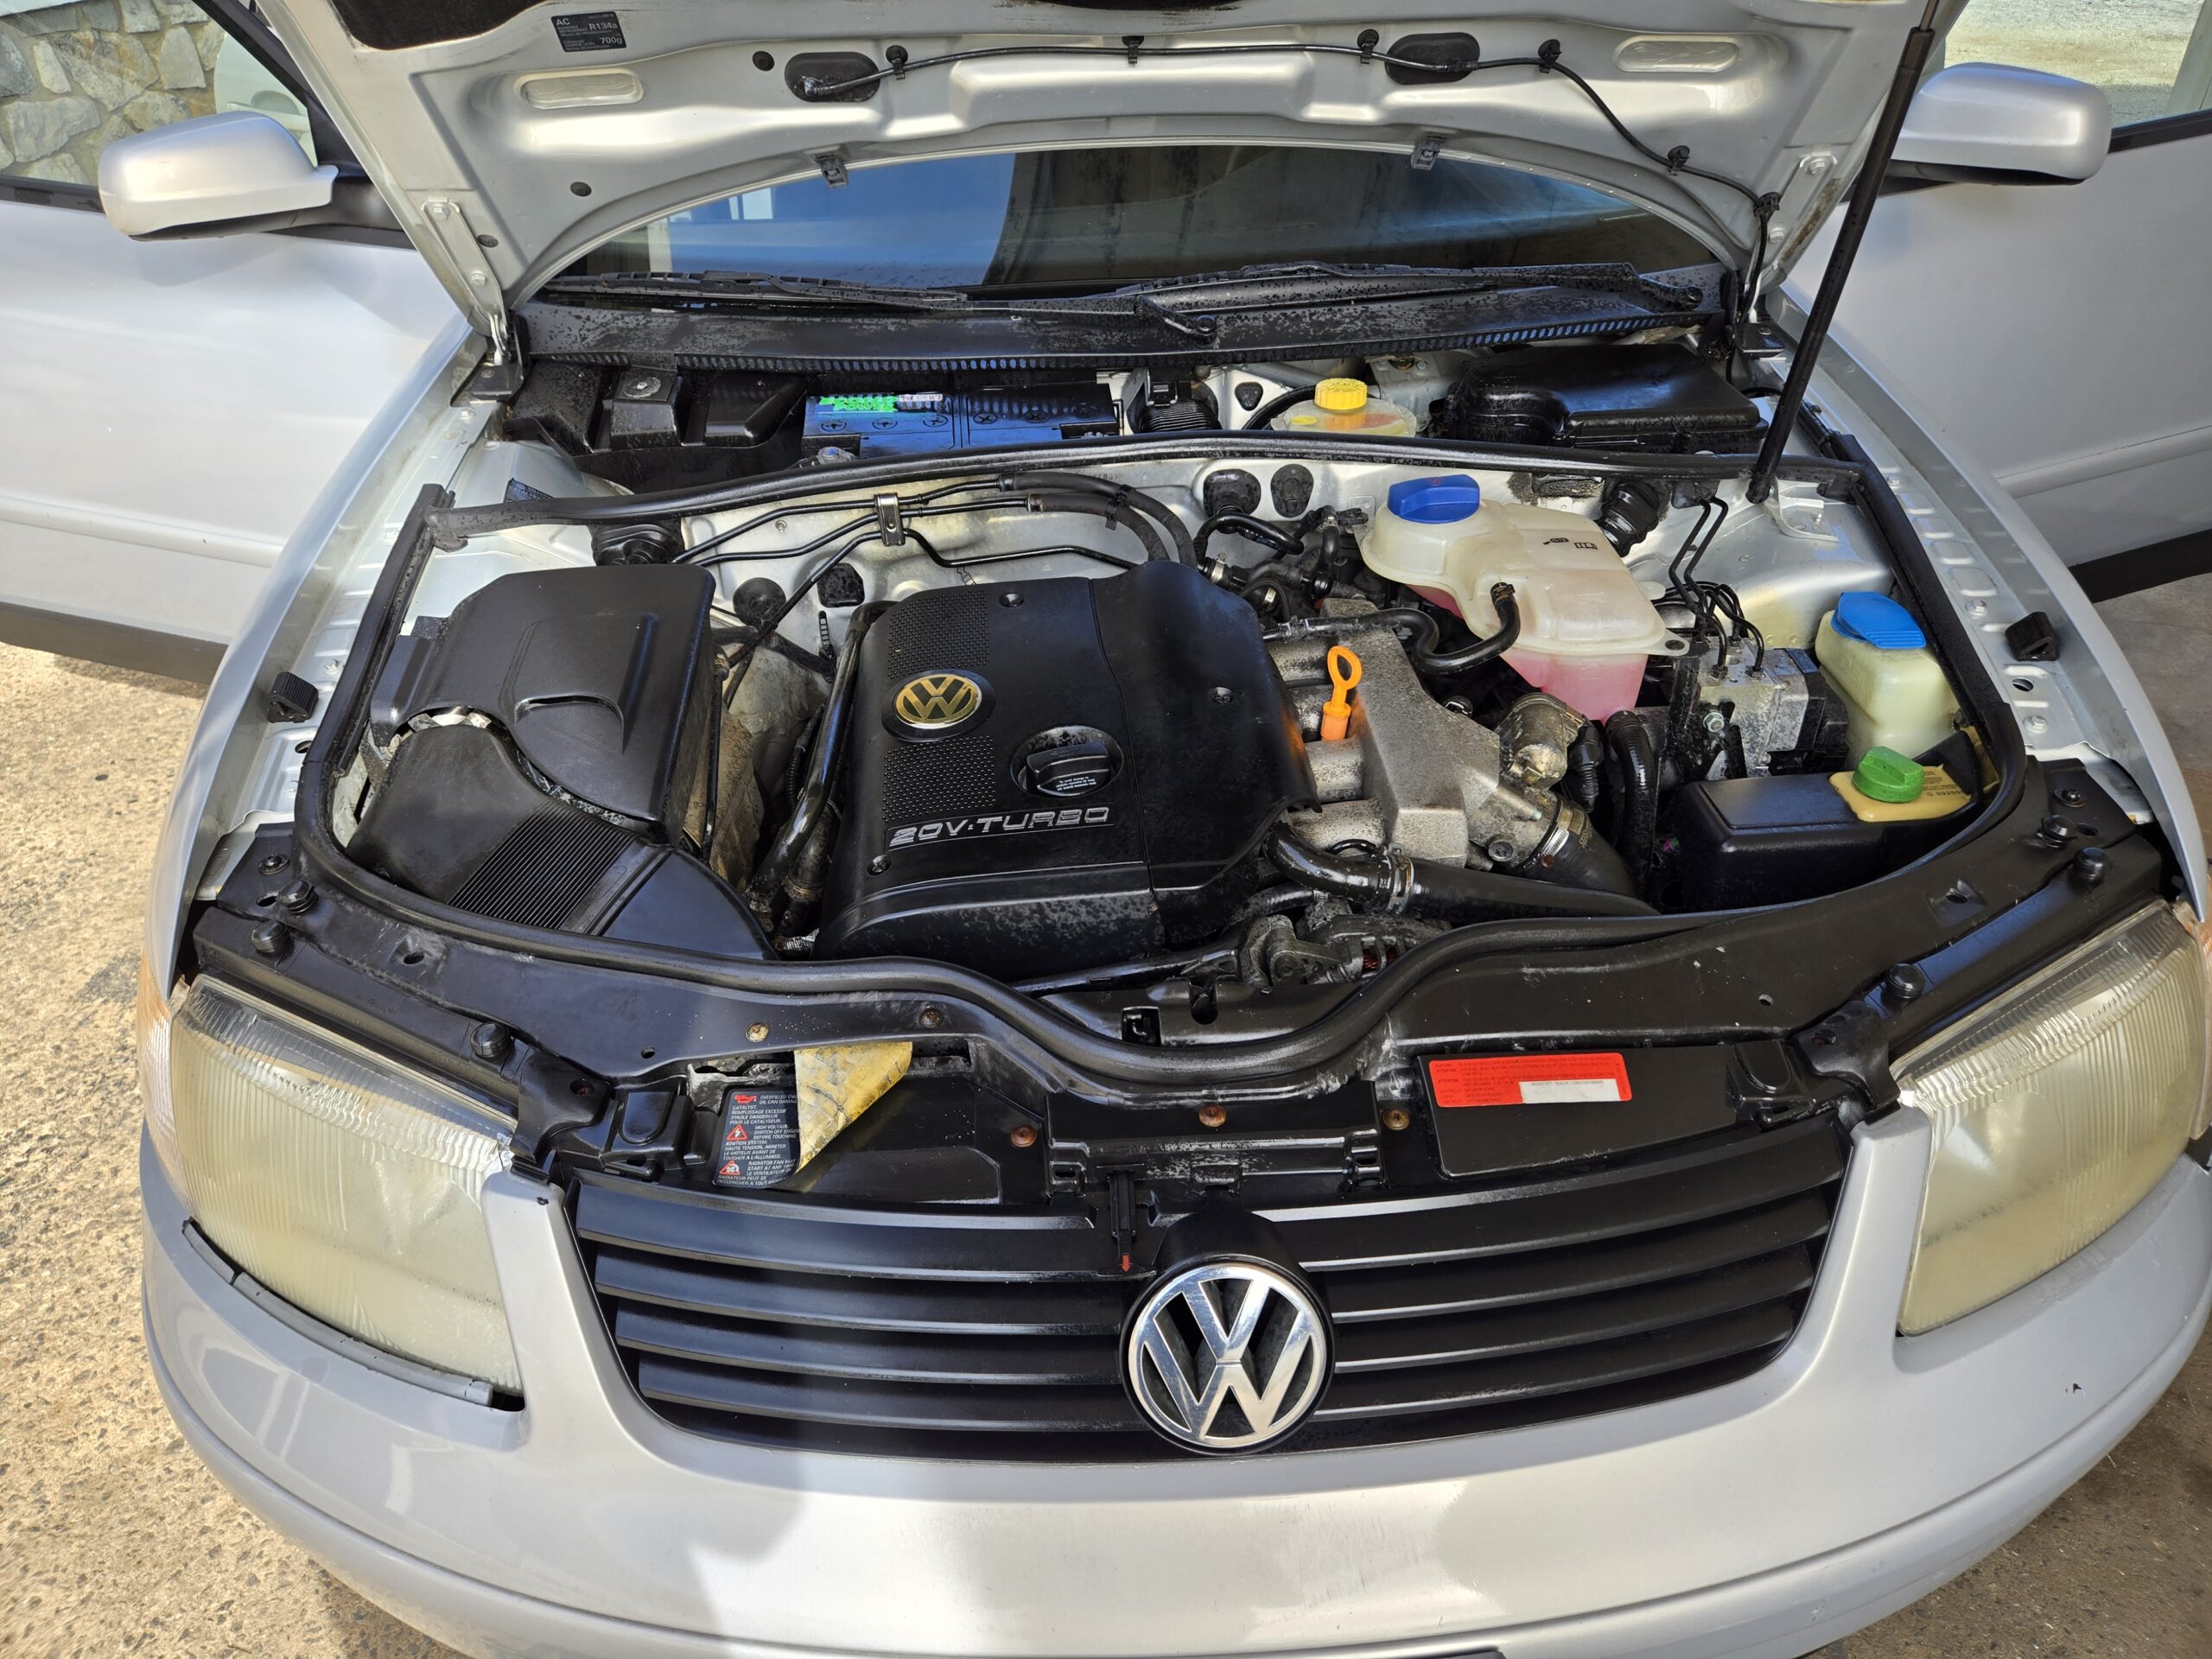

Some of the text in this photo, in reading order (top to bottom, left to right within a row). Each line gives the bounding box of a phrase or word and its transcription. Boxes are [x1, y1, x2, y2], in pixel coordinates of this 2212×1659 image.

[556, 17, 570, 26] AC
[589, 22, 618, 31] R134a
[600, 36, 623, 45] 700g
[1128, 1262, 1327, 1448] VW
